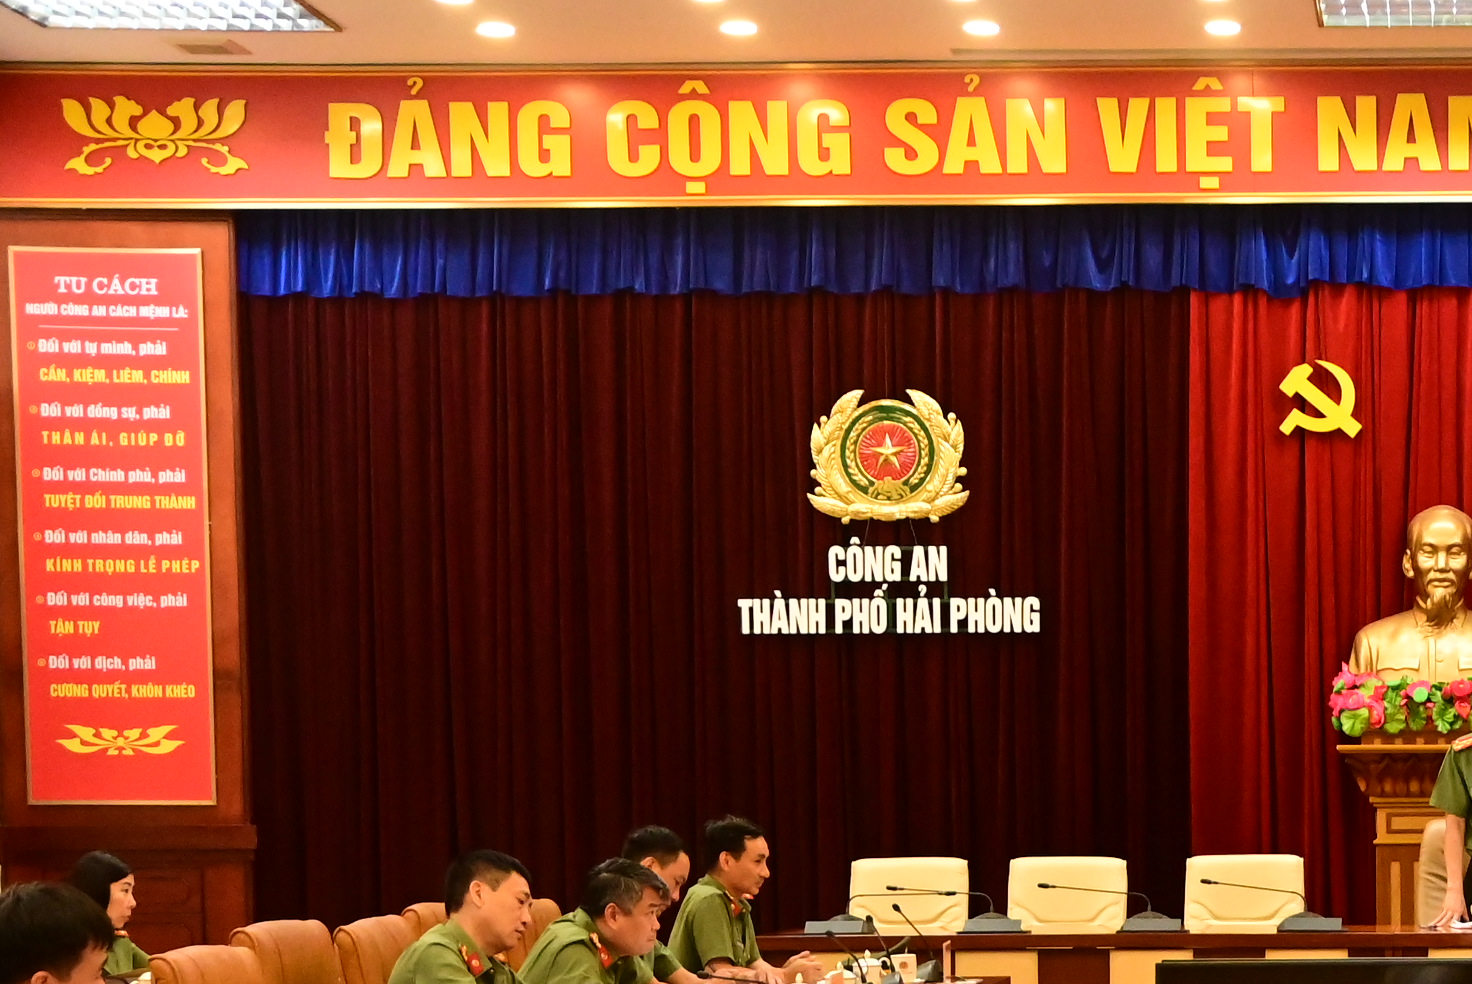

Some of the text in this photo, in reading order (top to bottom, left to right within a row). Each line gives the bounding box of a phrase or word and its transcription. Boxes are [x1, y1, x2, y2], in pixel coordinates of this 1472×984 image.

[325, 77, 572, 179] ĐẢNG
[606, 80, 851, 194] CỘNG
[884, 74, 1066, 175] SẢN
[1097, 76, 1284, 189] VIỆT
[829, 537, 947, 582] CÔNG AN
[738, 584, 1040, 634] THÀNH PHỐ HẢI PHÒNG
